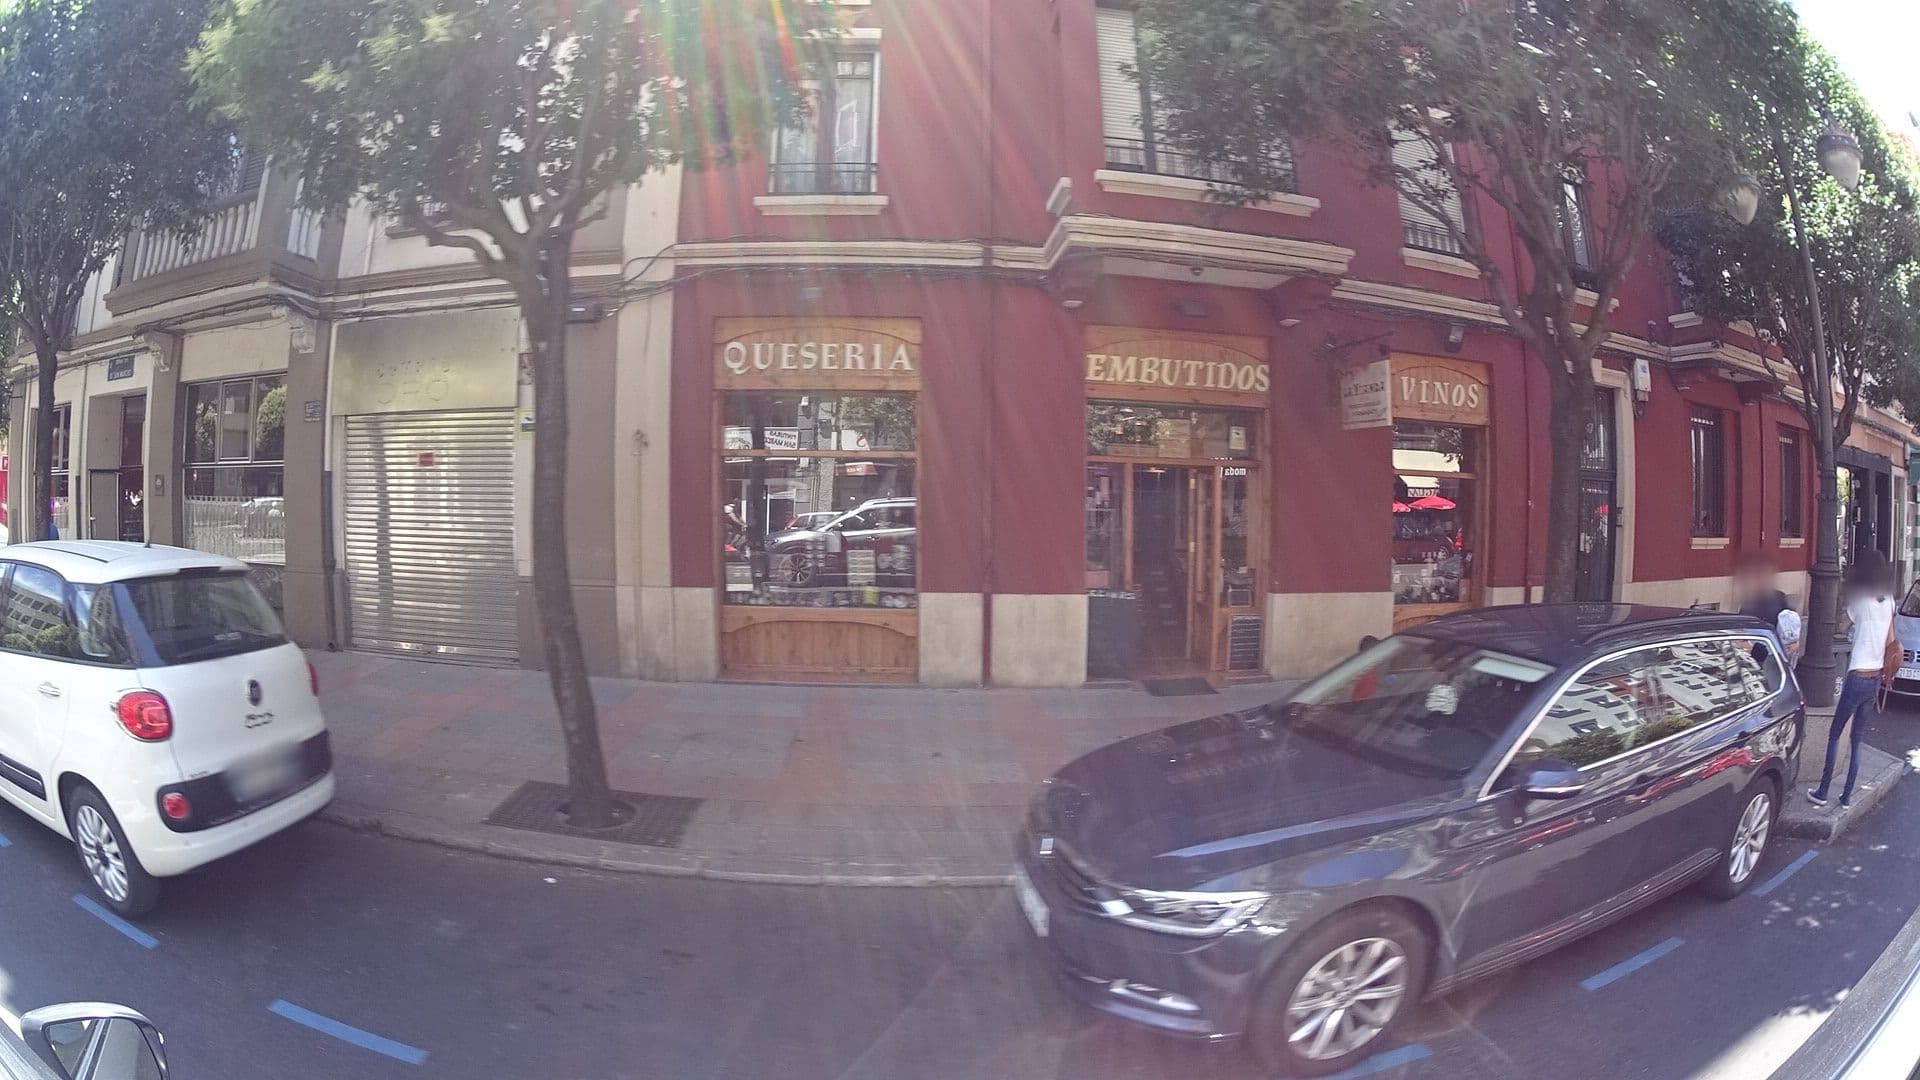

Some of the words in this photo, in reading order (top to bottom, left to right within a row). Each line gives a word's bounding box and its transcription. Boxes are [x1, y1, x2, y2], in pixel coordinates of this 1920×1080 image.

[723, 341, 914, 375] QUESERIA
[1085, 354, 1271, 392] EMBUTIDOS
[1400, 376, 1479, 409] VINOS
